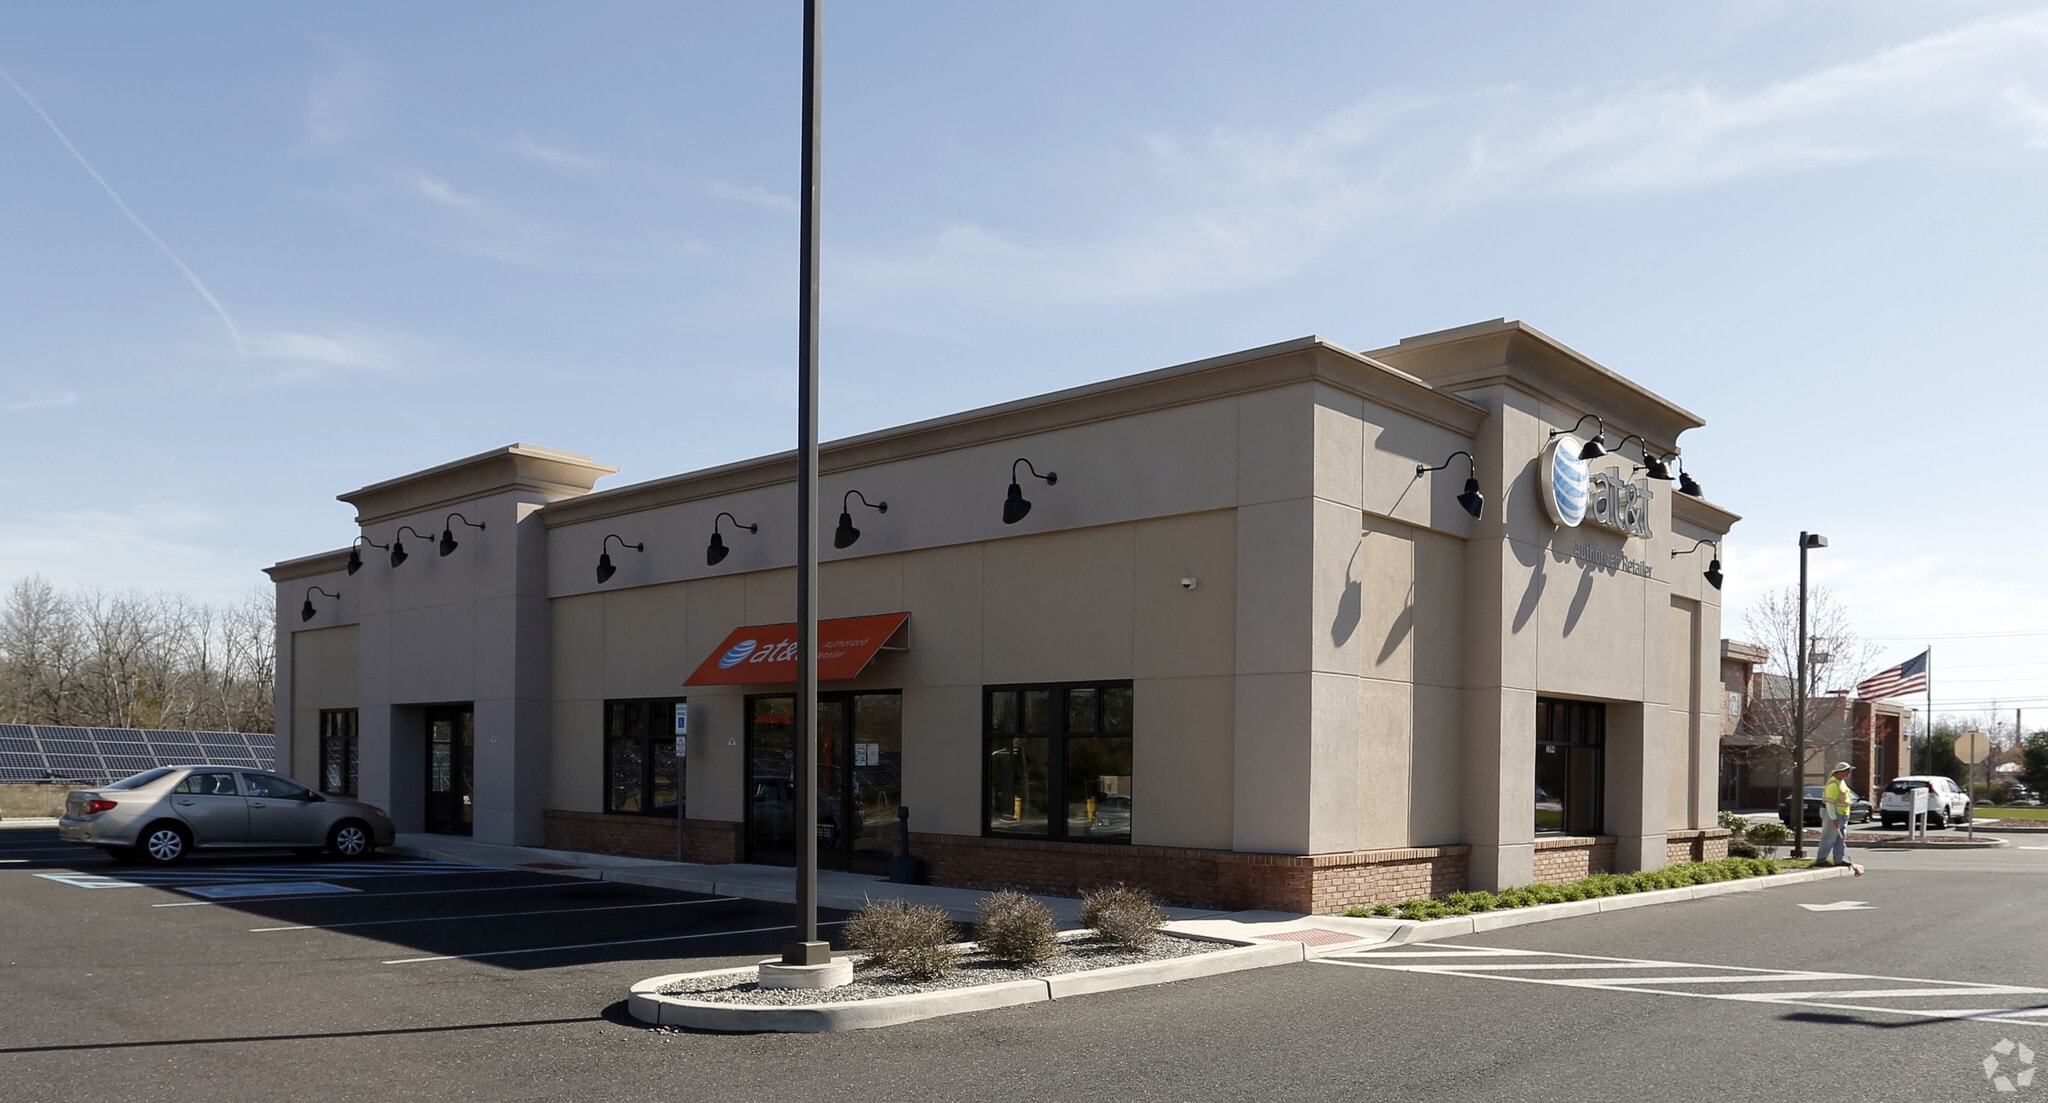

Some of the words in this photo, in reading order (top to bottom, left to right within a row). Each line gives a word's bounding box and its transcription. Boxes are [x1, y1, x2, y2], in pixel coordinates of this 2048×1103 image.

[1590, 466, 1654, 539] at&t
[1574, 540, 1624, 568] Authorized
[1622, 554, 1653, 578] Retailer
[749, 638, 797, 664] at&
